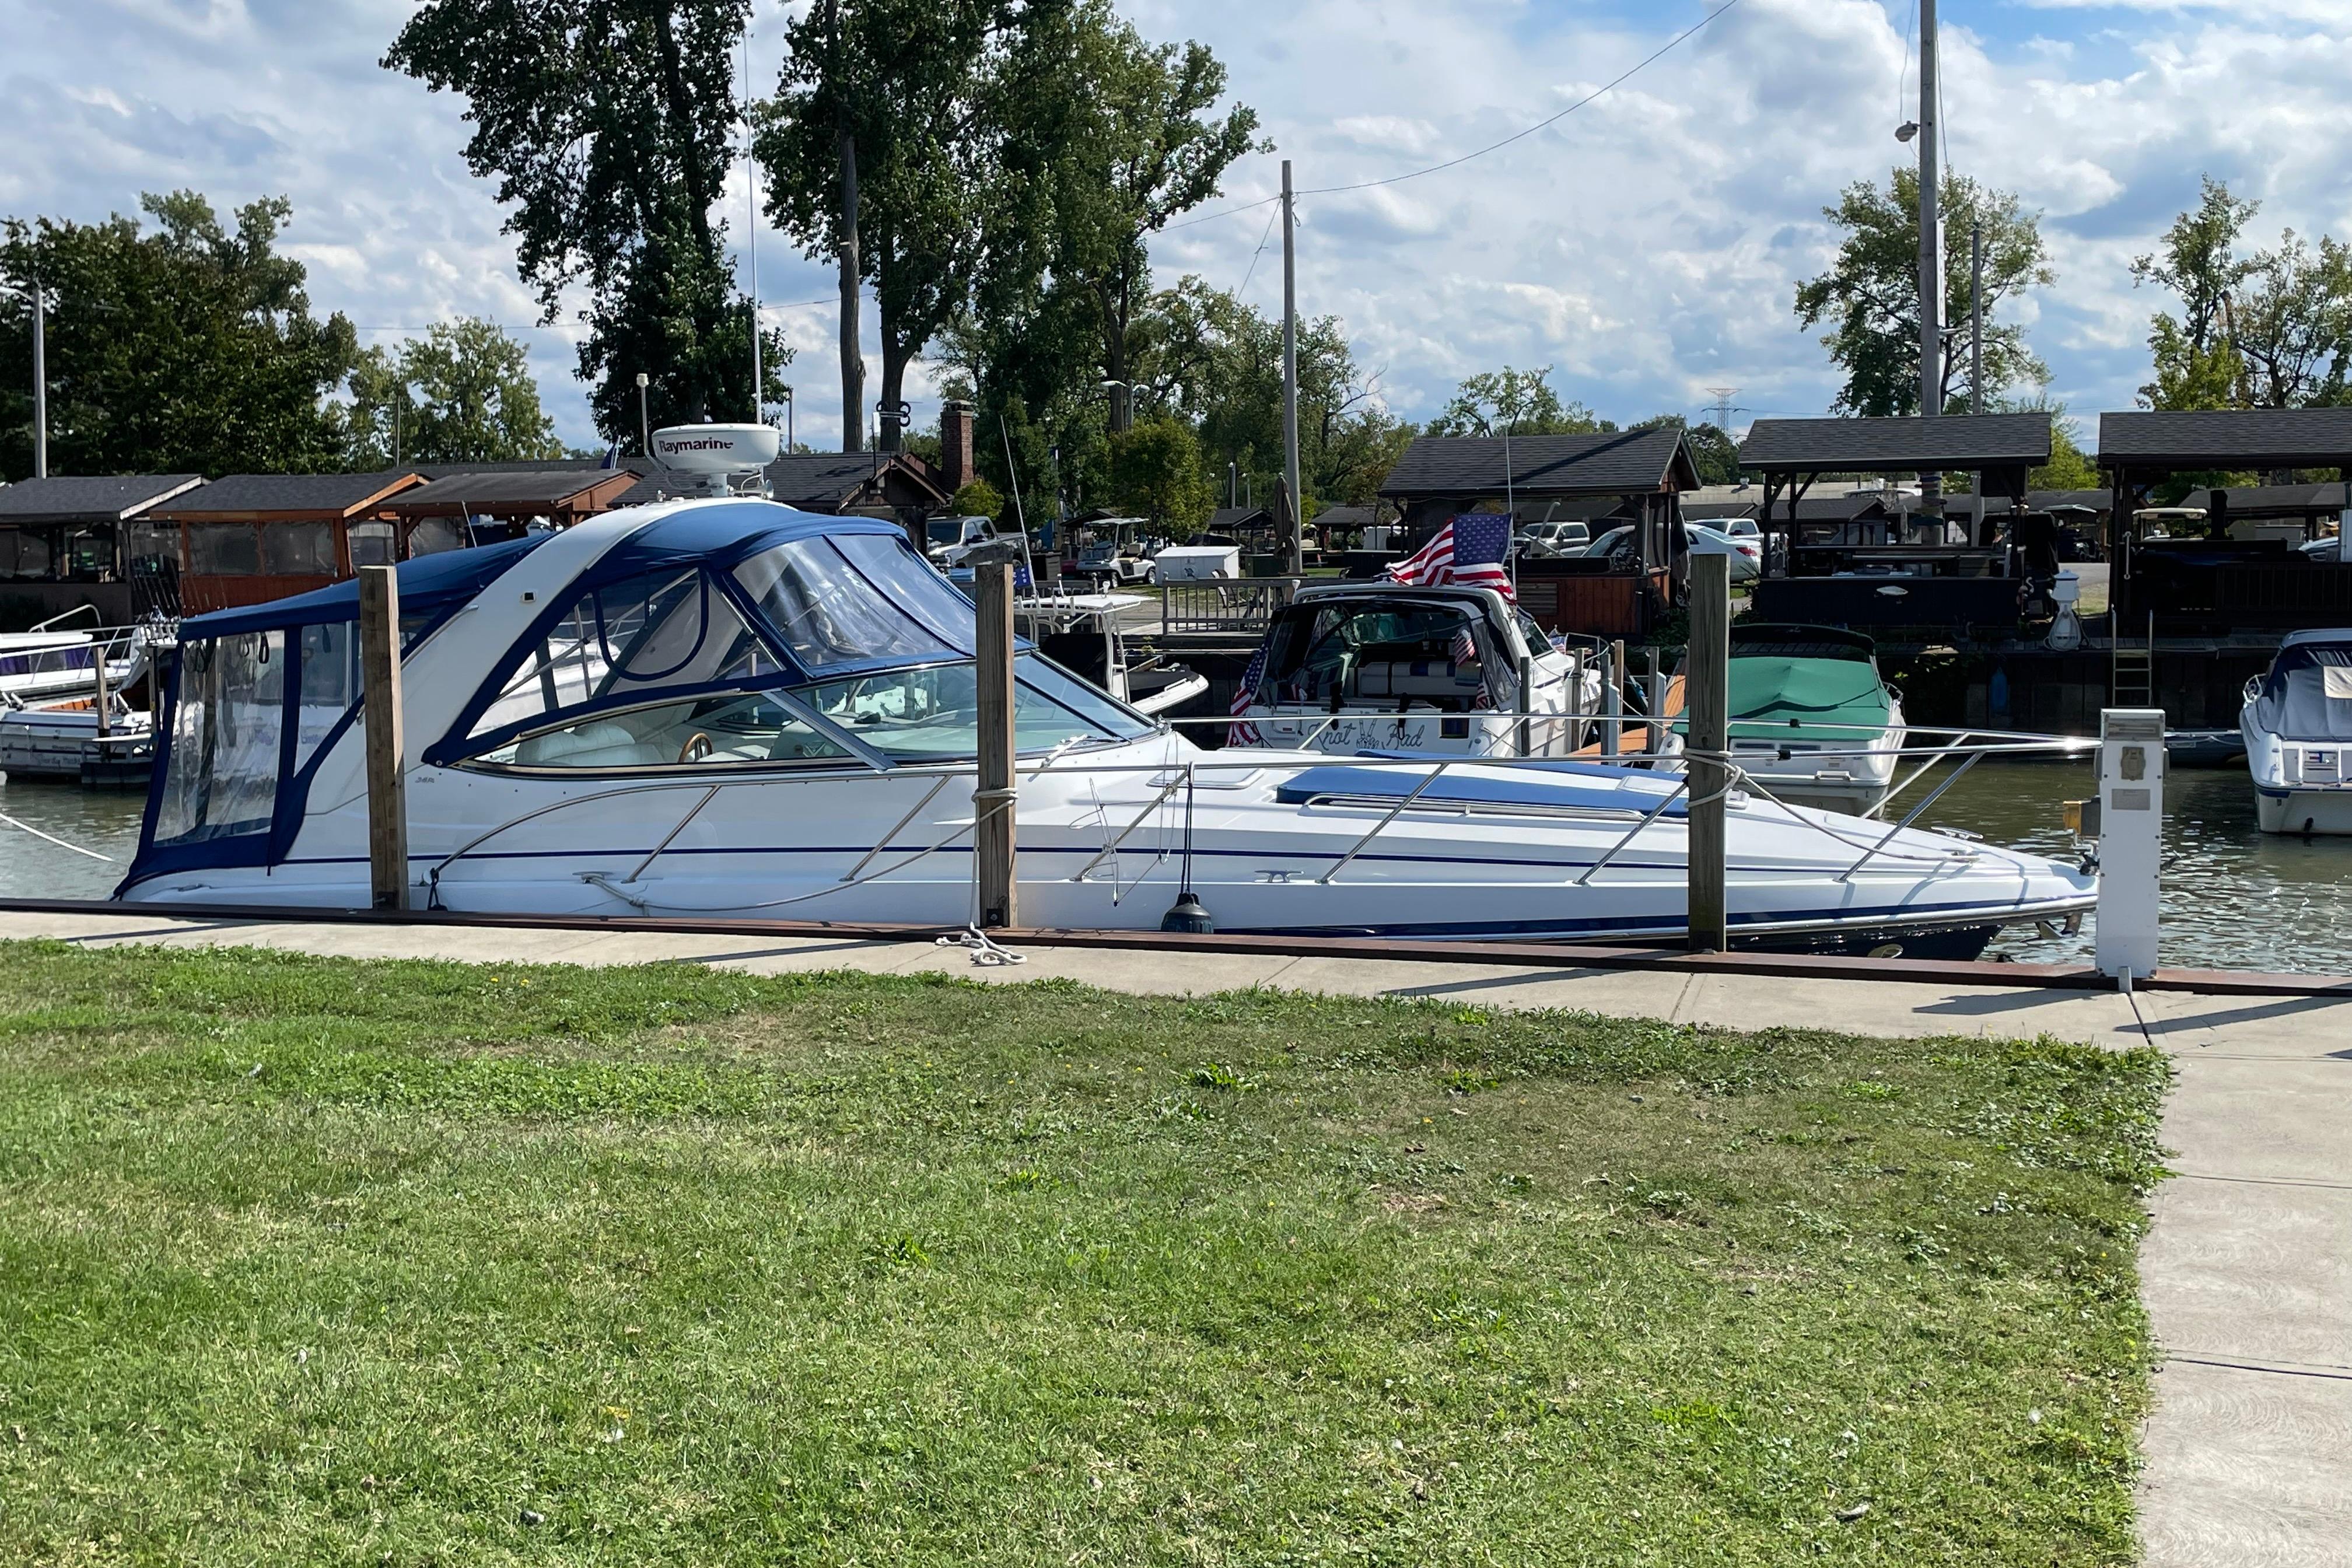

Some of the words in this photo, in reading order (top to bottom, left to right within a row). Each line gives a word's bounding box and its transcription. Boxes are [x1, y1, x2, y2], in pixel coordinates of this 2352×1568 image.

[659, 437, 733, 454] Raymarine
[1307, 722, 1356, 751] Knot
[1382, 723, 1425, 750] Bad
